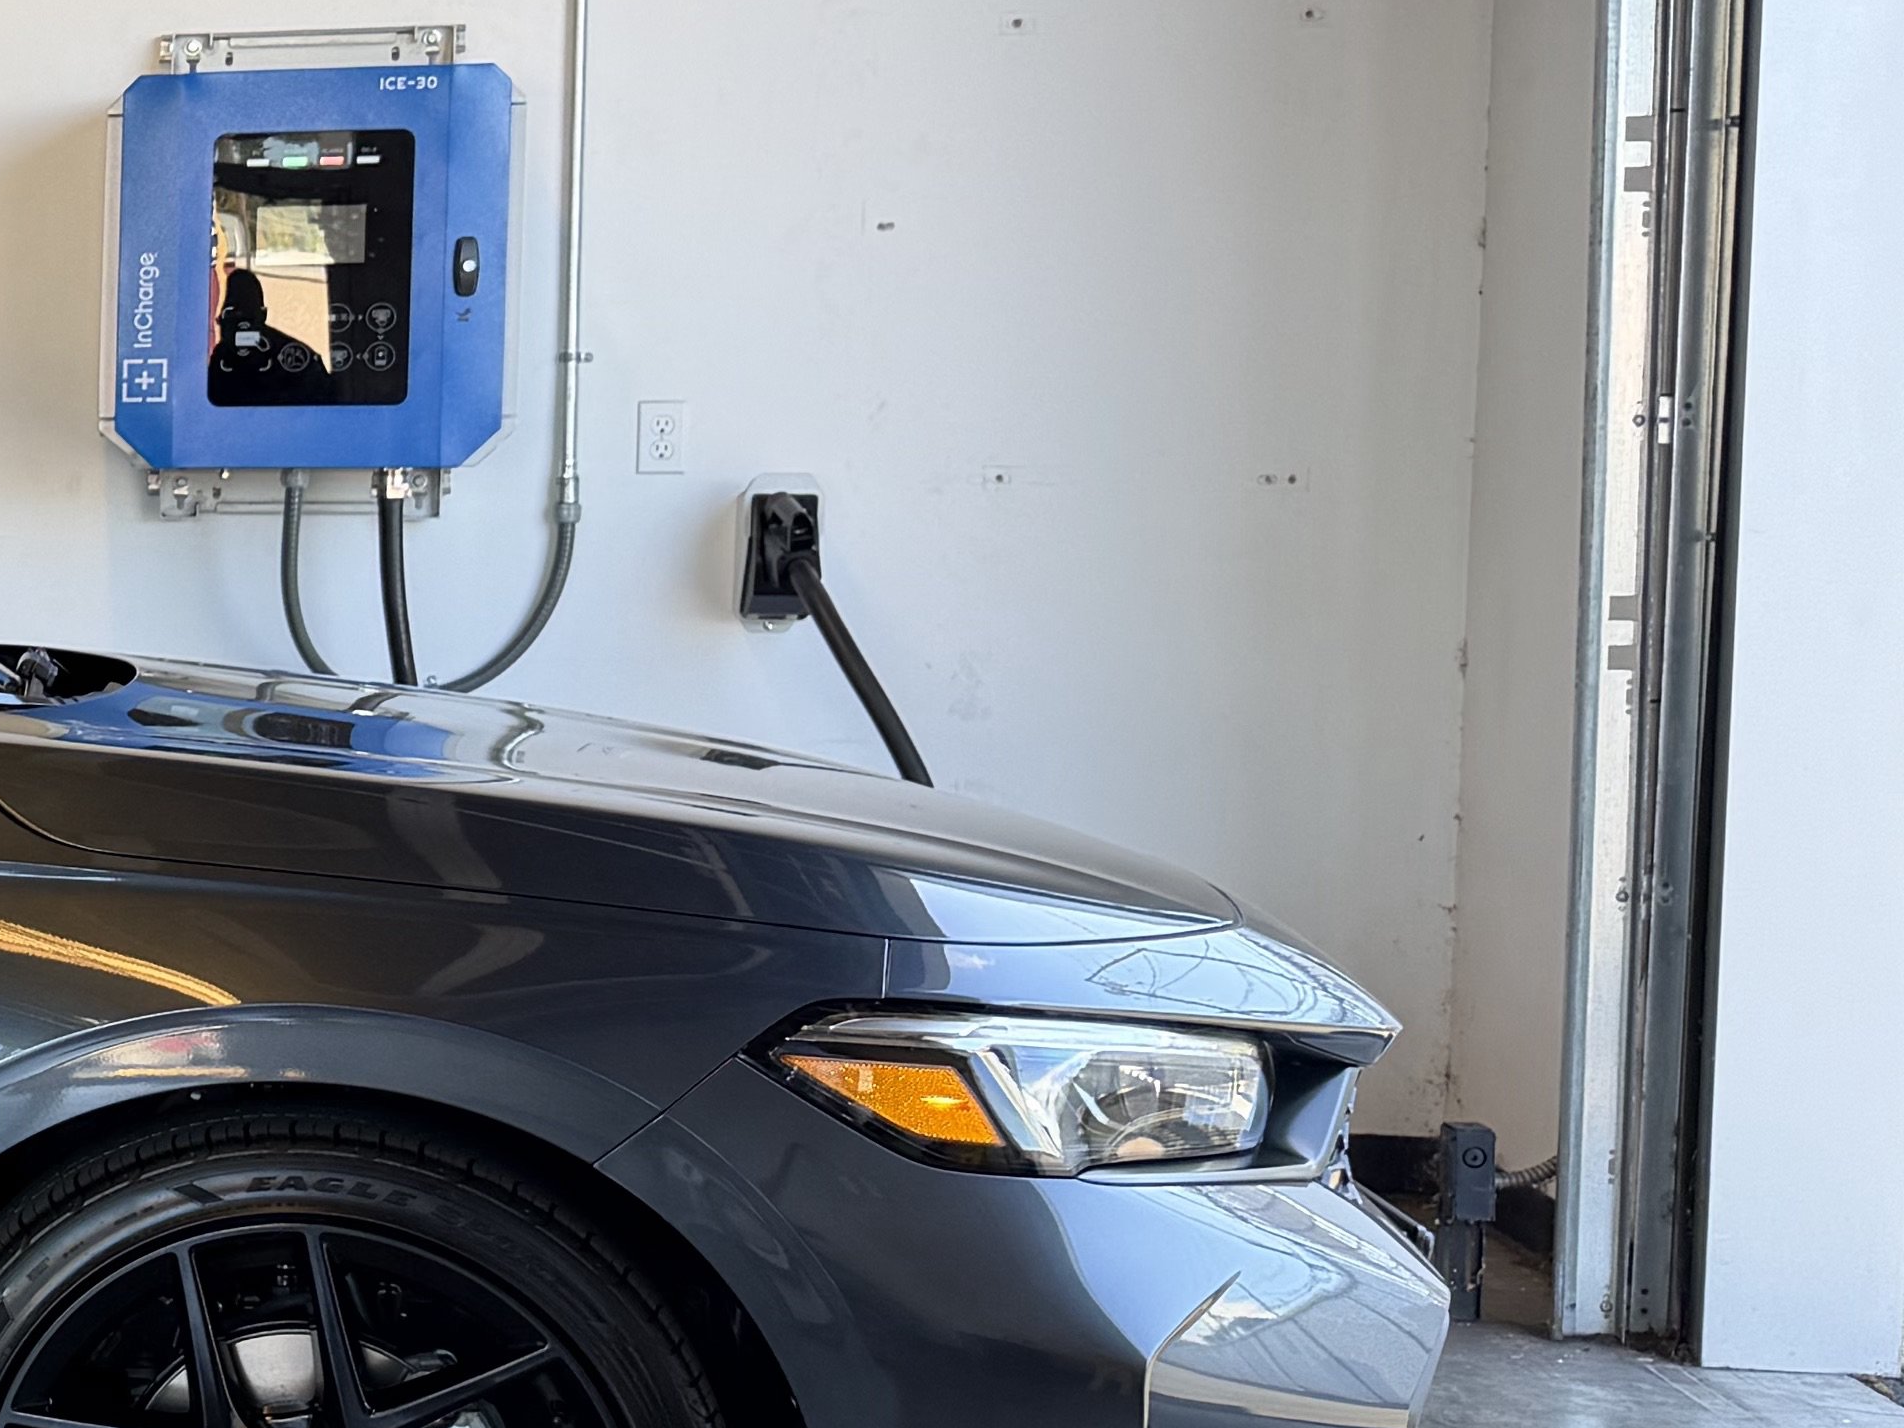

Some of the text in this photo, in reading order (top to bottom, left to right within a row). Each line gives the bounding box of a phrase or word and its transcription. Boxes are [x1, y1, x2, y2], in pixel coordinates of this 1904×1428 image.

[379, 75, 439, 91] ICE-30
[133, 252, 160, 349] InCharge
[244, 1175, 418, 1208] EAGLE
